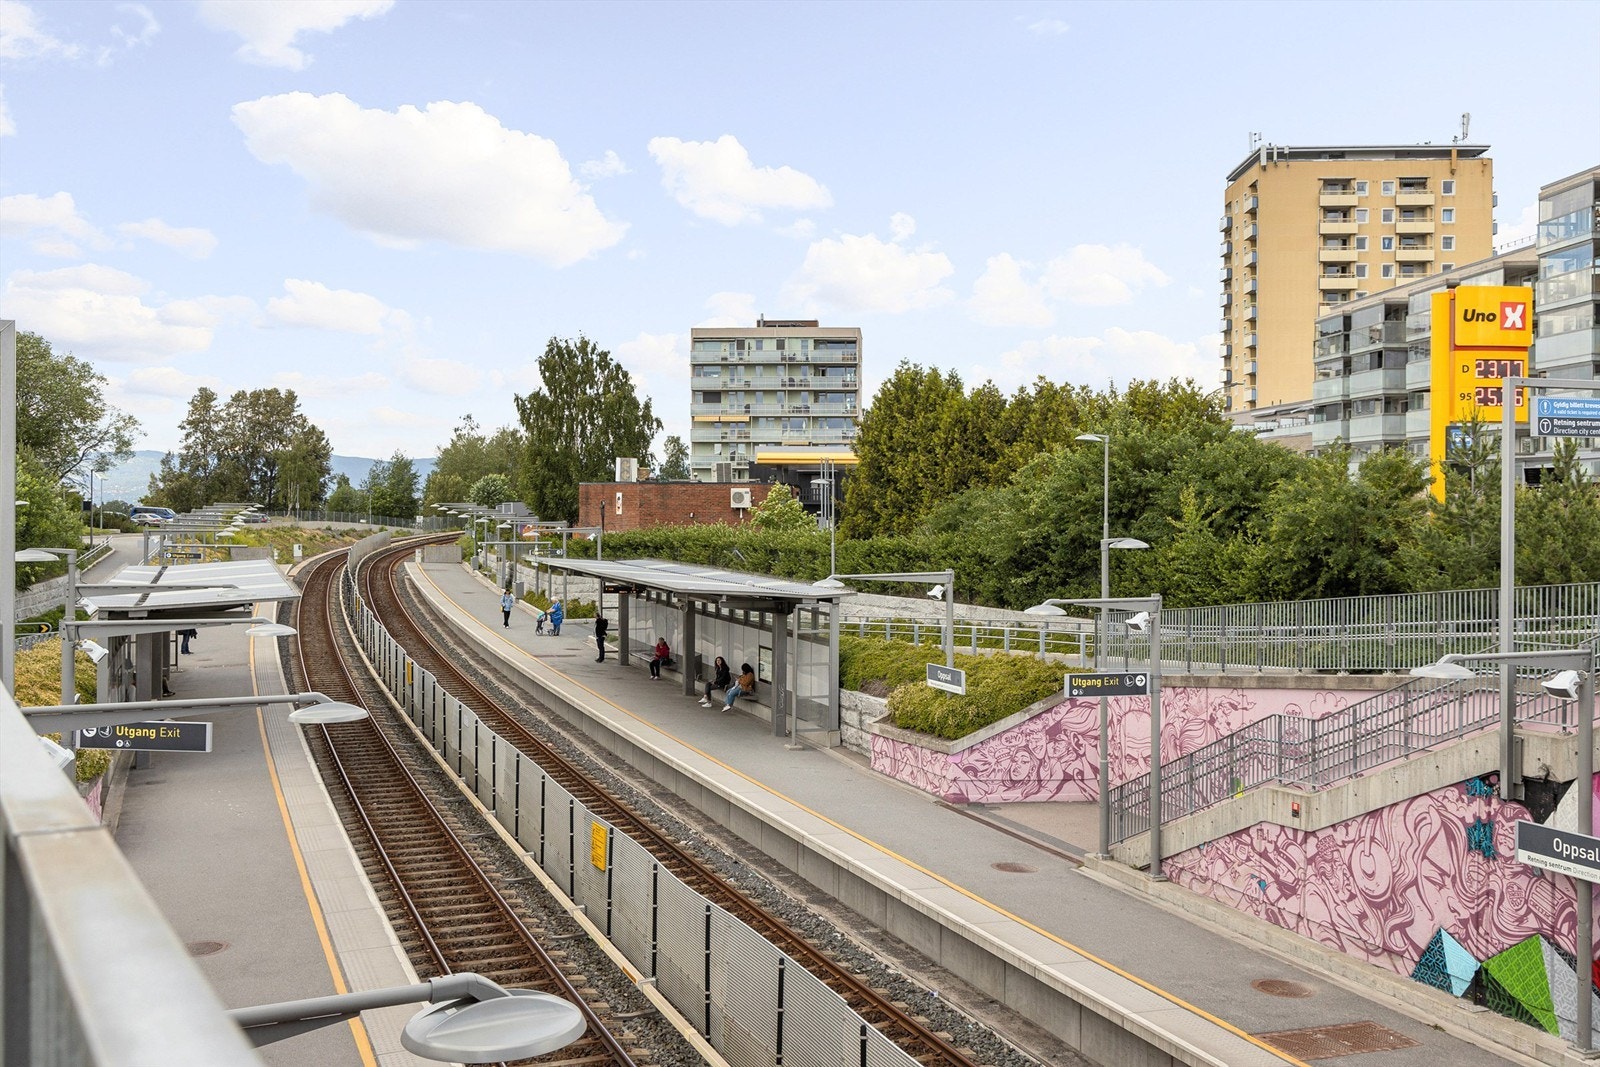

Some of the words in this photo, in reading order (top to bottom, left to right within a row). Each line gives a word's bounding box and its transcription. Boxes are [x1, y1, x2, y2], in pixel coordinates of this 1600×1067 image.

[1462, 309, 1497, 322] Uno
[1503, 304, 1525, 329] X
[1462, 364, 1470, 374] D
[1459, 392, 1472, 401] 95
[1475, 388, 1523, 407] 25.6
[1553, 418, 1576, 428] Retning
[1578, 428, 1589, 436] city
[937, 670, 952, 681] Oppsal
[1072, 677, 1102, 688] Utgang
[1104, 676, 1119, 686] Exit
[116, 725, 156, 740] Utgang
[159, 726, 181, 738] Exit
[1553, 837, 1600, 863] Oppsal
[1527, 855, 1548, 867] Retning
[1548, 861, 1572, 873] sentrum
[1572, 867, 1598, 878] Direction
